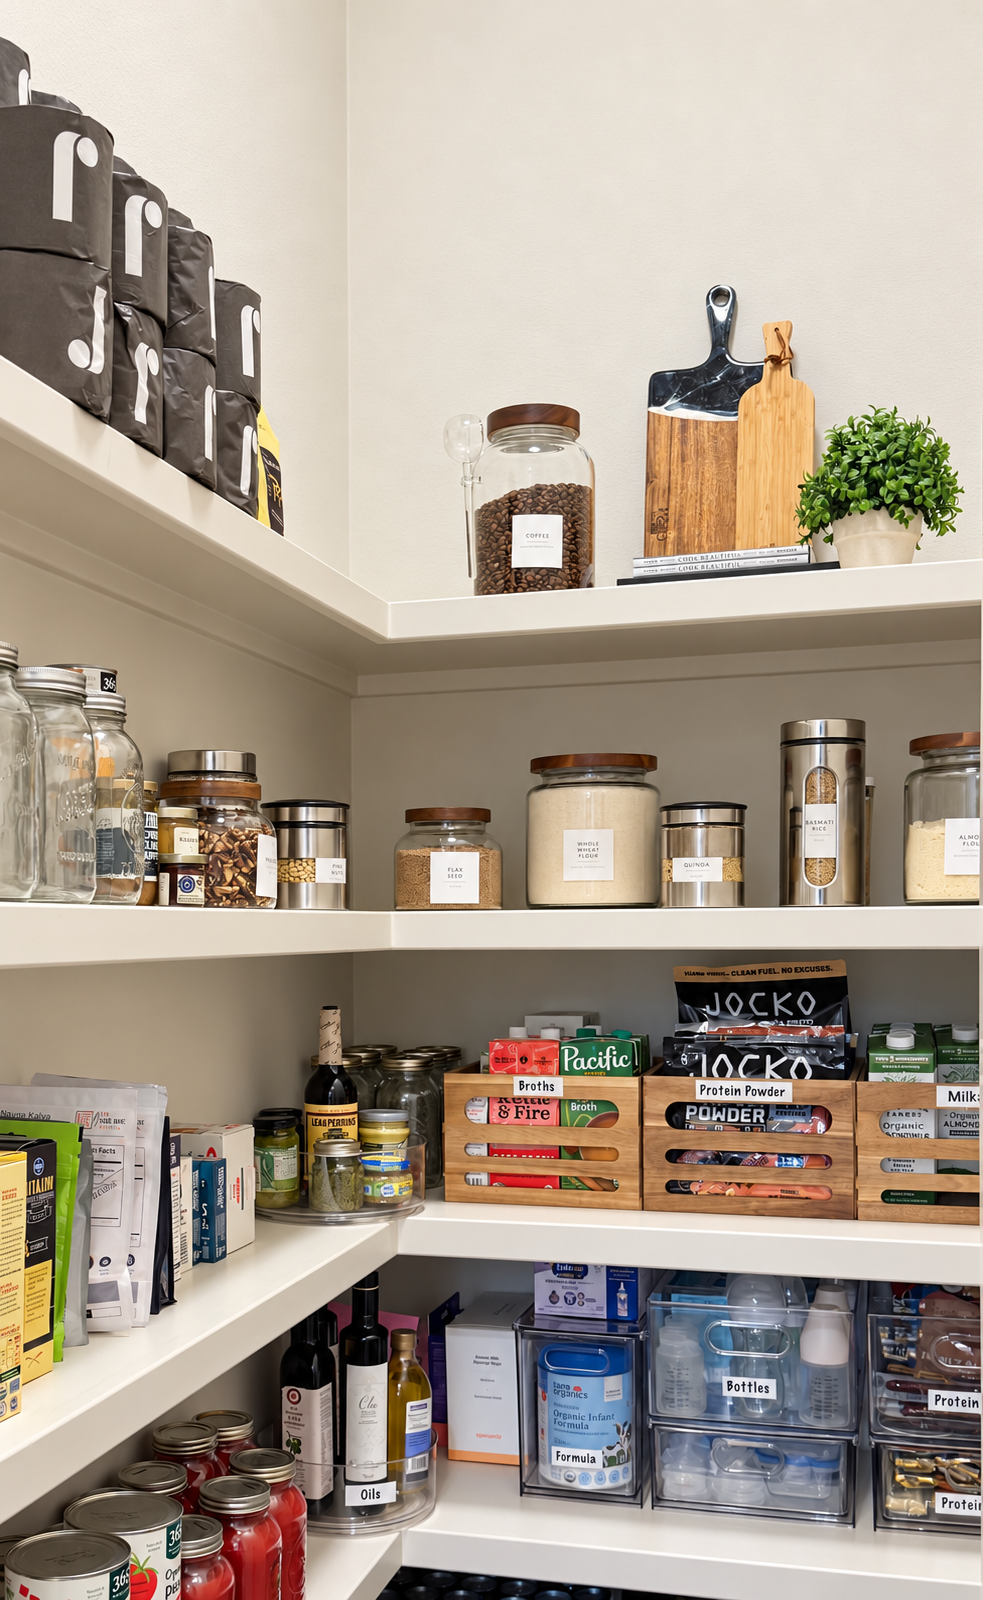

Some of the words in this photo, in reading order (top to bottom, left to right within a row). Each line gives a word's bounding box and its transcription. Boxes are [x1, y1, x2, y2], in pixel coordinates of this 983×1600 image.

[781, 966, 793, 974] NO
[794, 964, 833, 974] EXCUSES.
[705, 991, 817, 1017] JOCKO
[561, 1045, 631, 1072] Pacific
[688, 1052, 813, 1080] JOCKO
[519, 1080, 555, 1092] Broths
[700, 1083, 741, 1097] Protein
[745, 1084, 786, 1098] Powder
[514, 1105, 550, 1120] Fire
[571, 1101, 597, 1111] Broth
[685, 1104, 766, 1124] POWDER
[883, 1121, 924, 1131] Organic
[98, 1147, 116, 1155] Facts
[553, 1388, 589, 1399] organics
[726, 1380, 770, 1394] Bottles
[934, 1394, 980, 1409] Protein
[553, 1409, 586, 1421] Organic
[588, 1412, 615, 1421] Infant
[553, 1418, 589, 1430] Formula
[555, 1450, 597, 1465] Formula
[360, 1487, 381, 1501] Oils
